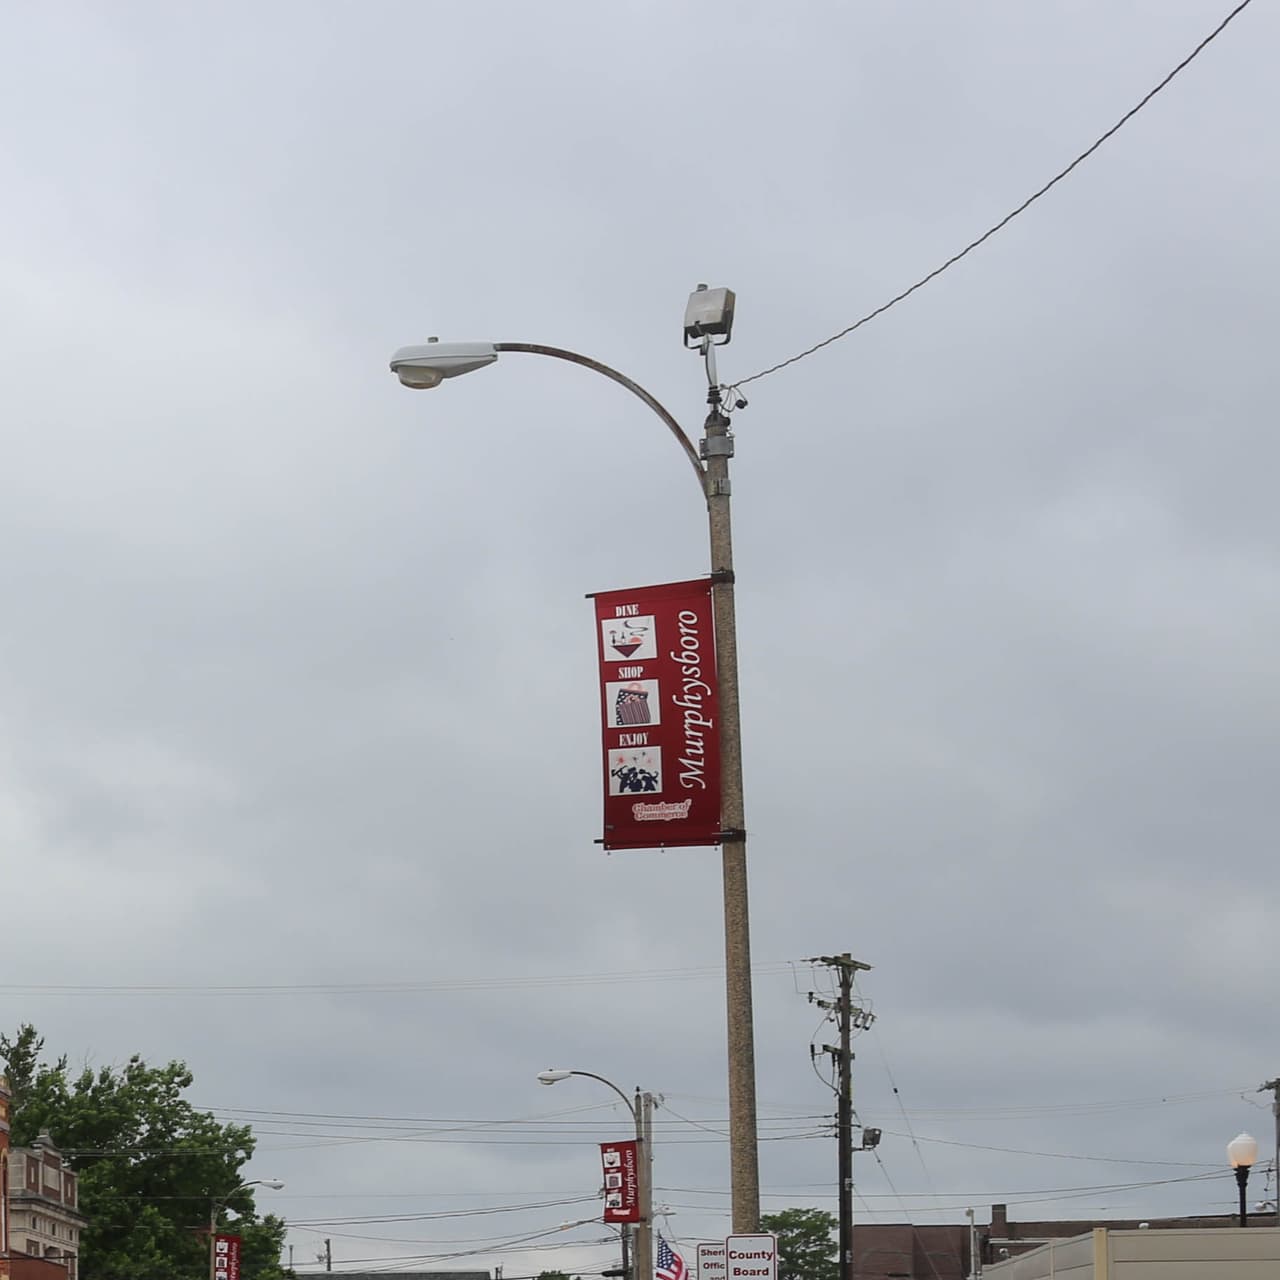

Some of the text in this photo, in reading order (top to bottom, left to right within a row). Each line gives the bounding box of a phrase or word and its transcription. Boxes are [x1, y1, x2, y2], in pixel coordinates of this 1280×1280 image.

[615, 604, 639, 617] DINE
[618, 666, 644, 679] SHOP
[670, 610, 713, 790] Murphysboro
[619, 732, 648, 747] ENJOY
[632, 802, 675, 813] Chamber
[634, 811, 688, 821] Commerce
[729, 1250, 774, 1261] County
[733, 1267, 769, 1276] Board
